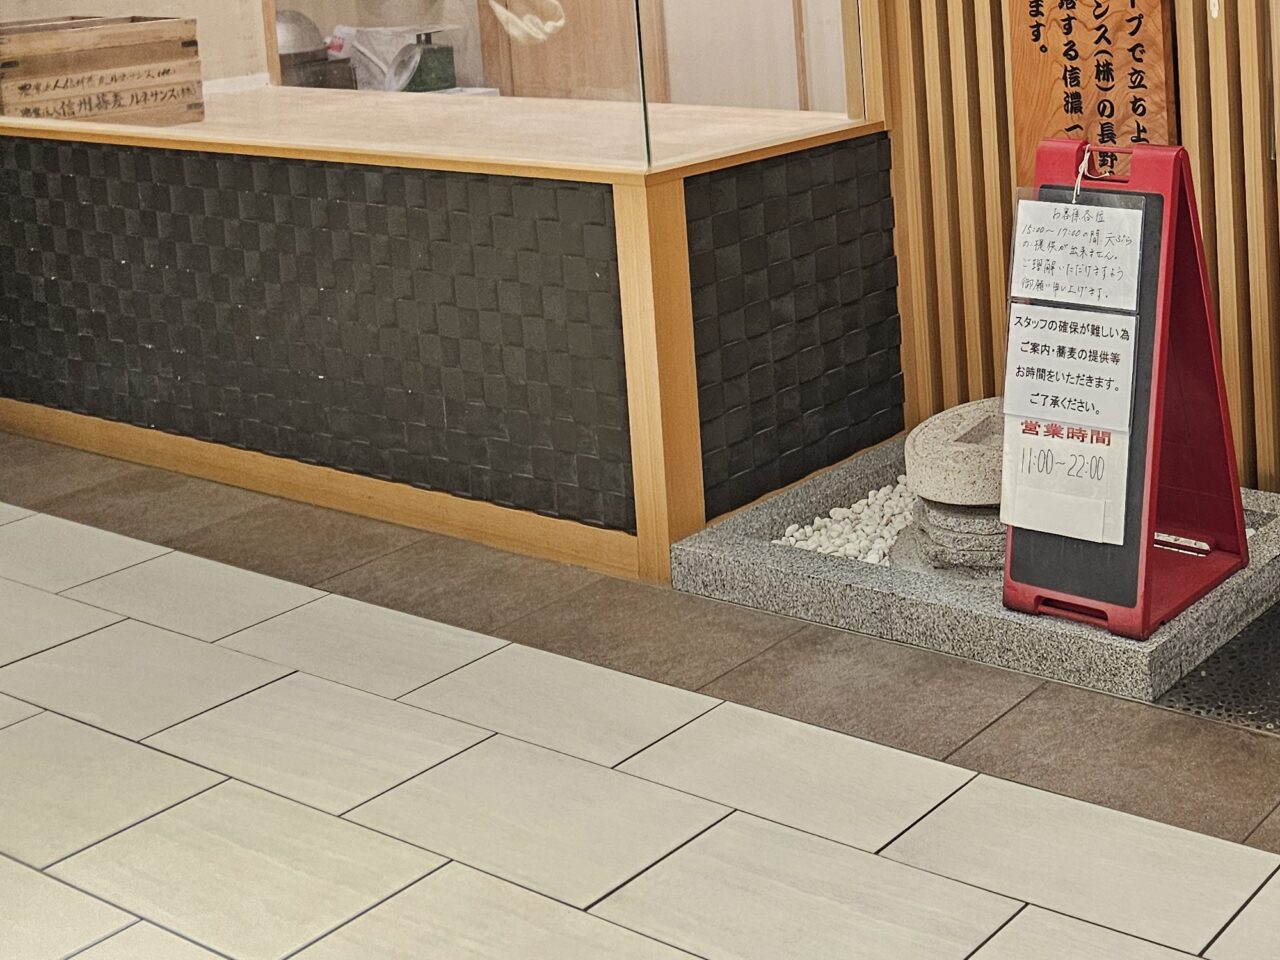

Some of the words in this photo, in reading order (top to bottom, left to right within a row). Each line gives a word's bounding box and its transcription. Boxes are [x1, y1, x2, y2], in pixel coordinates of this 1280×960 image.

[1013, 315, 1130, 341] スタッフの確保が難しい為
[1020, 341, 1121, 366] ご案内・蕎麦の提供等
[1015, 365, 1119, 392] お時間をいただきます。
[1030, 392, 1101, 415] ご了承ください。
[1021, 420, 1111, 447] 営業時間
